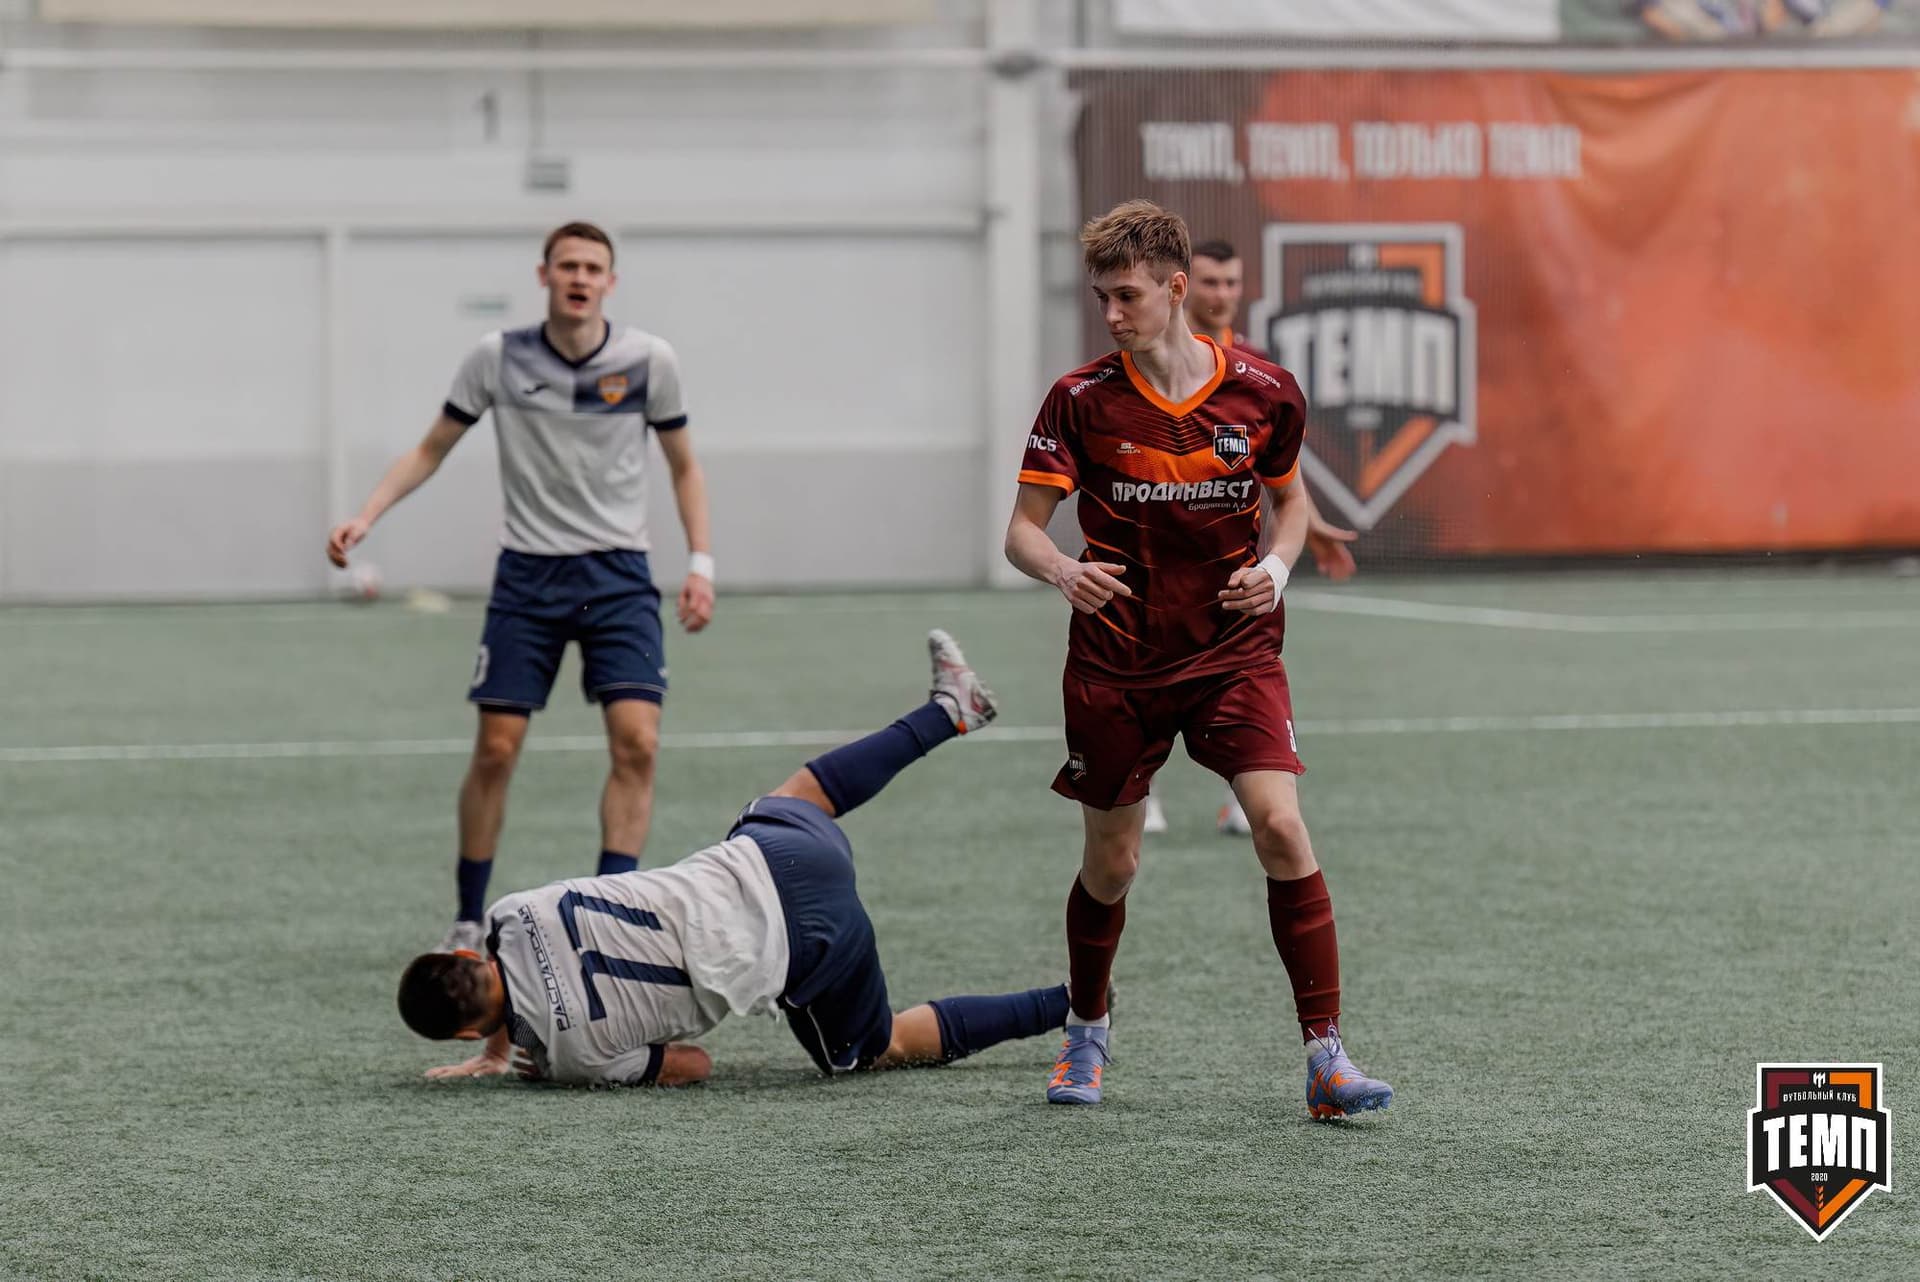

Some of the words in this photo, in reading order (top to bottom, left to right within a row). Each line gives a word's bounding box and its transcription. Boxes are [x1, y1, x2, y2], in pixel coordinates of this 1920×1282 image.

[1272, 307, 1456, 414] ТЕМП
[1217, 437, 1247, 454] ТЕМП
[1112, 480, 1254, 503] ПРОДИНВЕСТ
[558, 889, 693, 1022] 77
